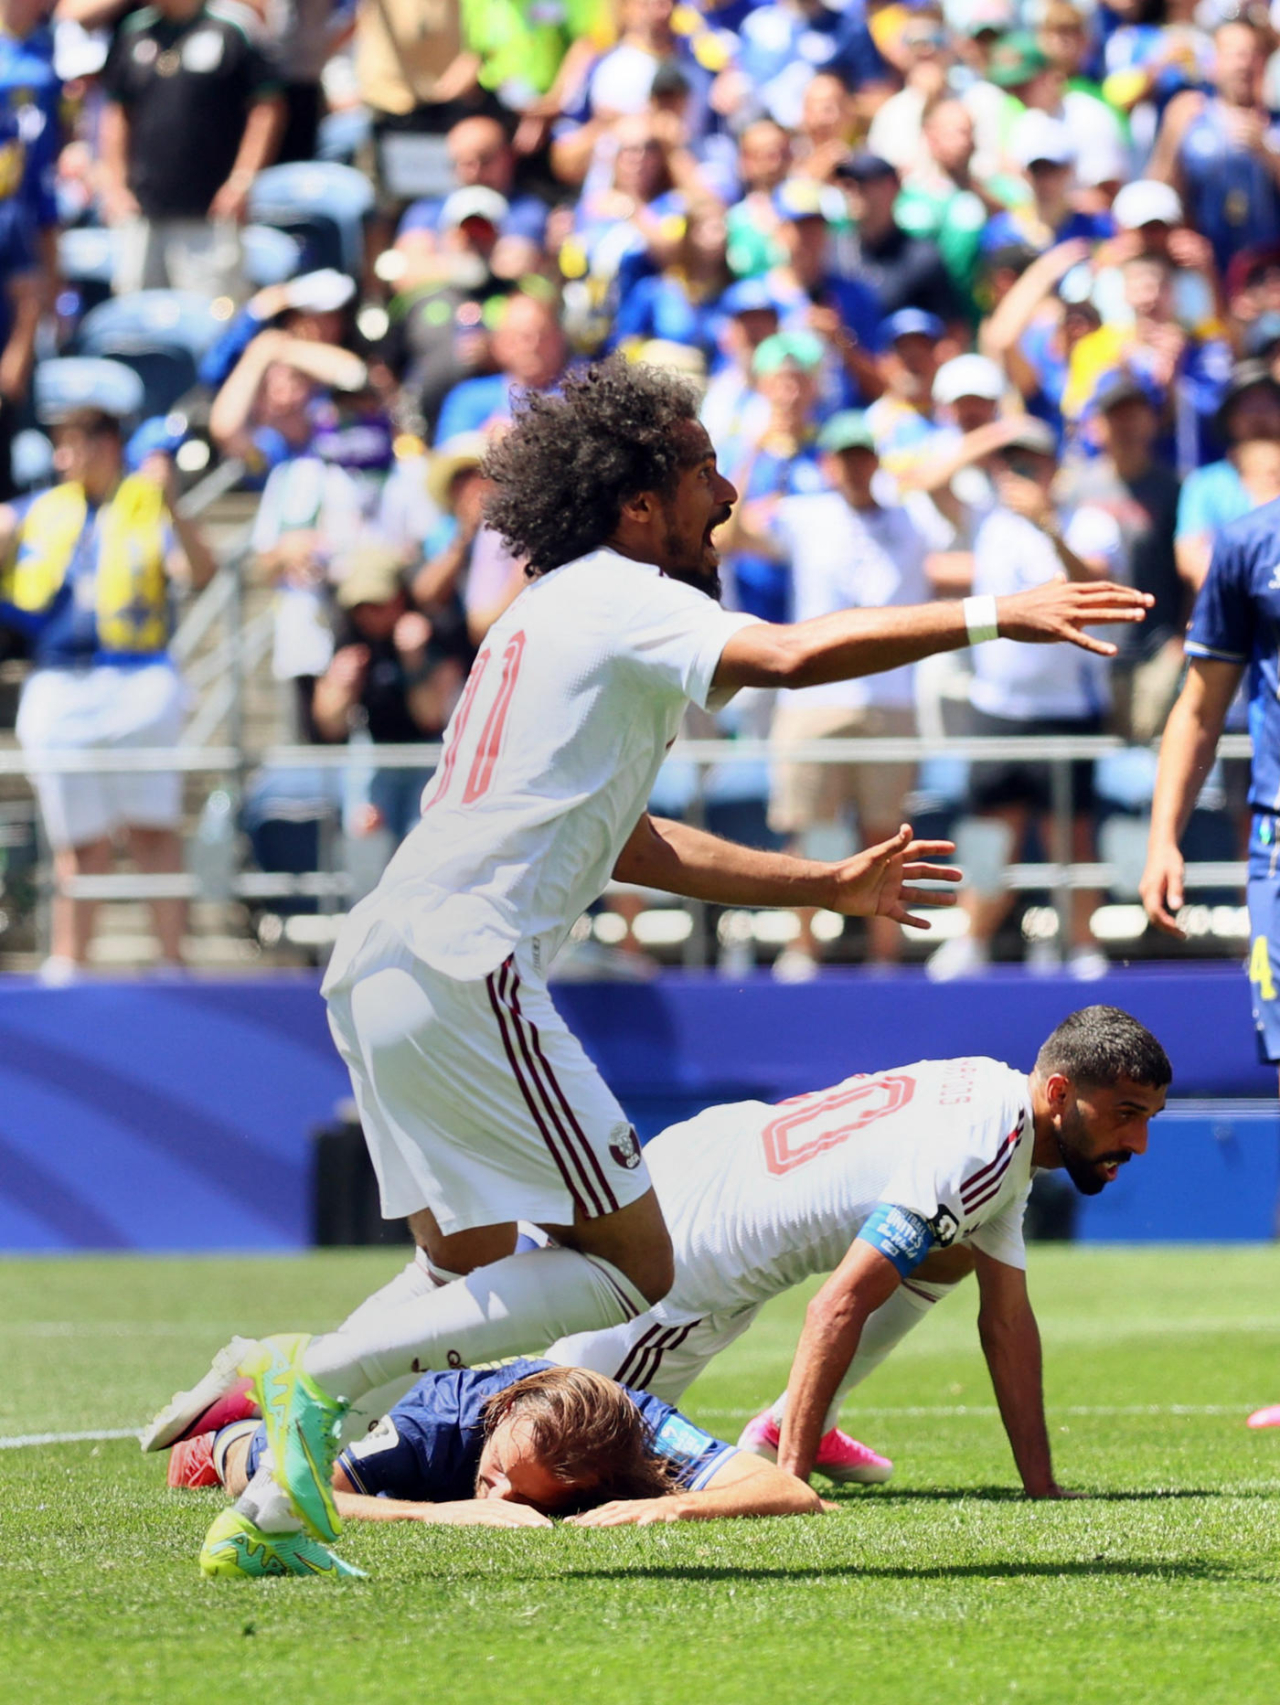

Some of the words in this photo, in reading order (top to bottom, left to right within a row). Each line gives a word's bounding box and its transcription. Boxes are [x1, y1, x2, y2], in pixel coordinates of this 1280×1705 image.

[1248, 935, 1277, 1001] 4
[761, 1073, 917, 1176] 0
[886, 1208, 925, 1248] UNITES
[891, 1232, 918, 1259] World
